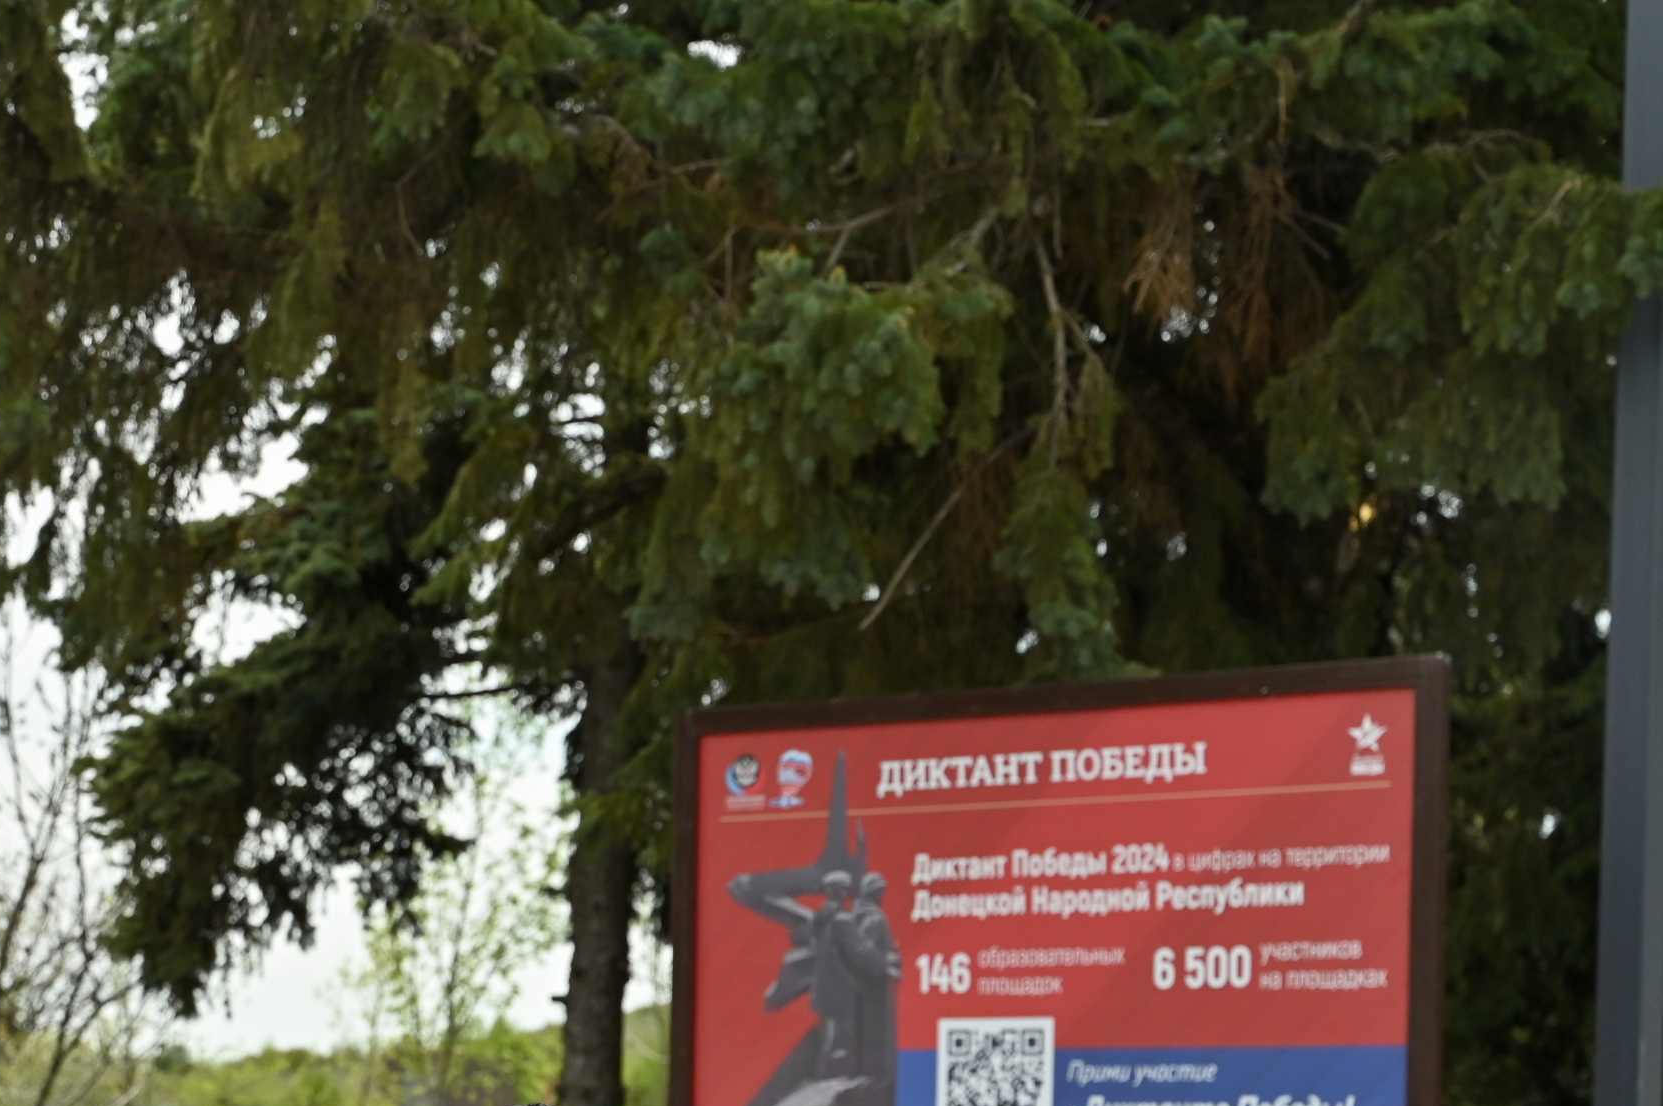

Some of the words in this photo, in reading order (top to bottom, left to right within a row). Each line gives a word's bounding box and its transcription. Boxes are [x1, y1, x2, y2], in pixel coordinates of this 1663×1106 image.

[876, 751, 1043, 799] ДИКТАНТ
[1049, 741, 1208, 785] ПОБЕДЫ
[911, 853, 1008, 886] Диктант
[1011, 846, 1107, 881] Победы
[1111, 842, 1169, 875] 2024
[1173, 853, 1185, 872] в
[1189, 847, 1256, 873] цифрах
[1259, 849, 1282, 869] на
[1286, 844, 1390, 870] территории
[911, 885, 1027, 922] Донецкой
[1031, 880, 1151, 920] Народной
[1156, 877, 1305, 915] Республики
[977, 944, 1126, 972] образовательных
[1153, 946, 1176, 990] 6
[1184, 944, 1253, 989] 500
[1259, 939, 1363, 966] участников
[916, 952, 972, 995] 146
[977, 976, 1064, 996] площадок
[1259, 971, 1283, 990] на
[1287, 968, 1388, 992] площадках
[1067, 1059, 1133, 1084] Прими
[1134, 1062, 1218, 1087] участие
